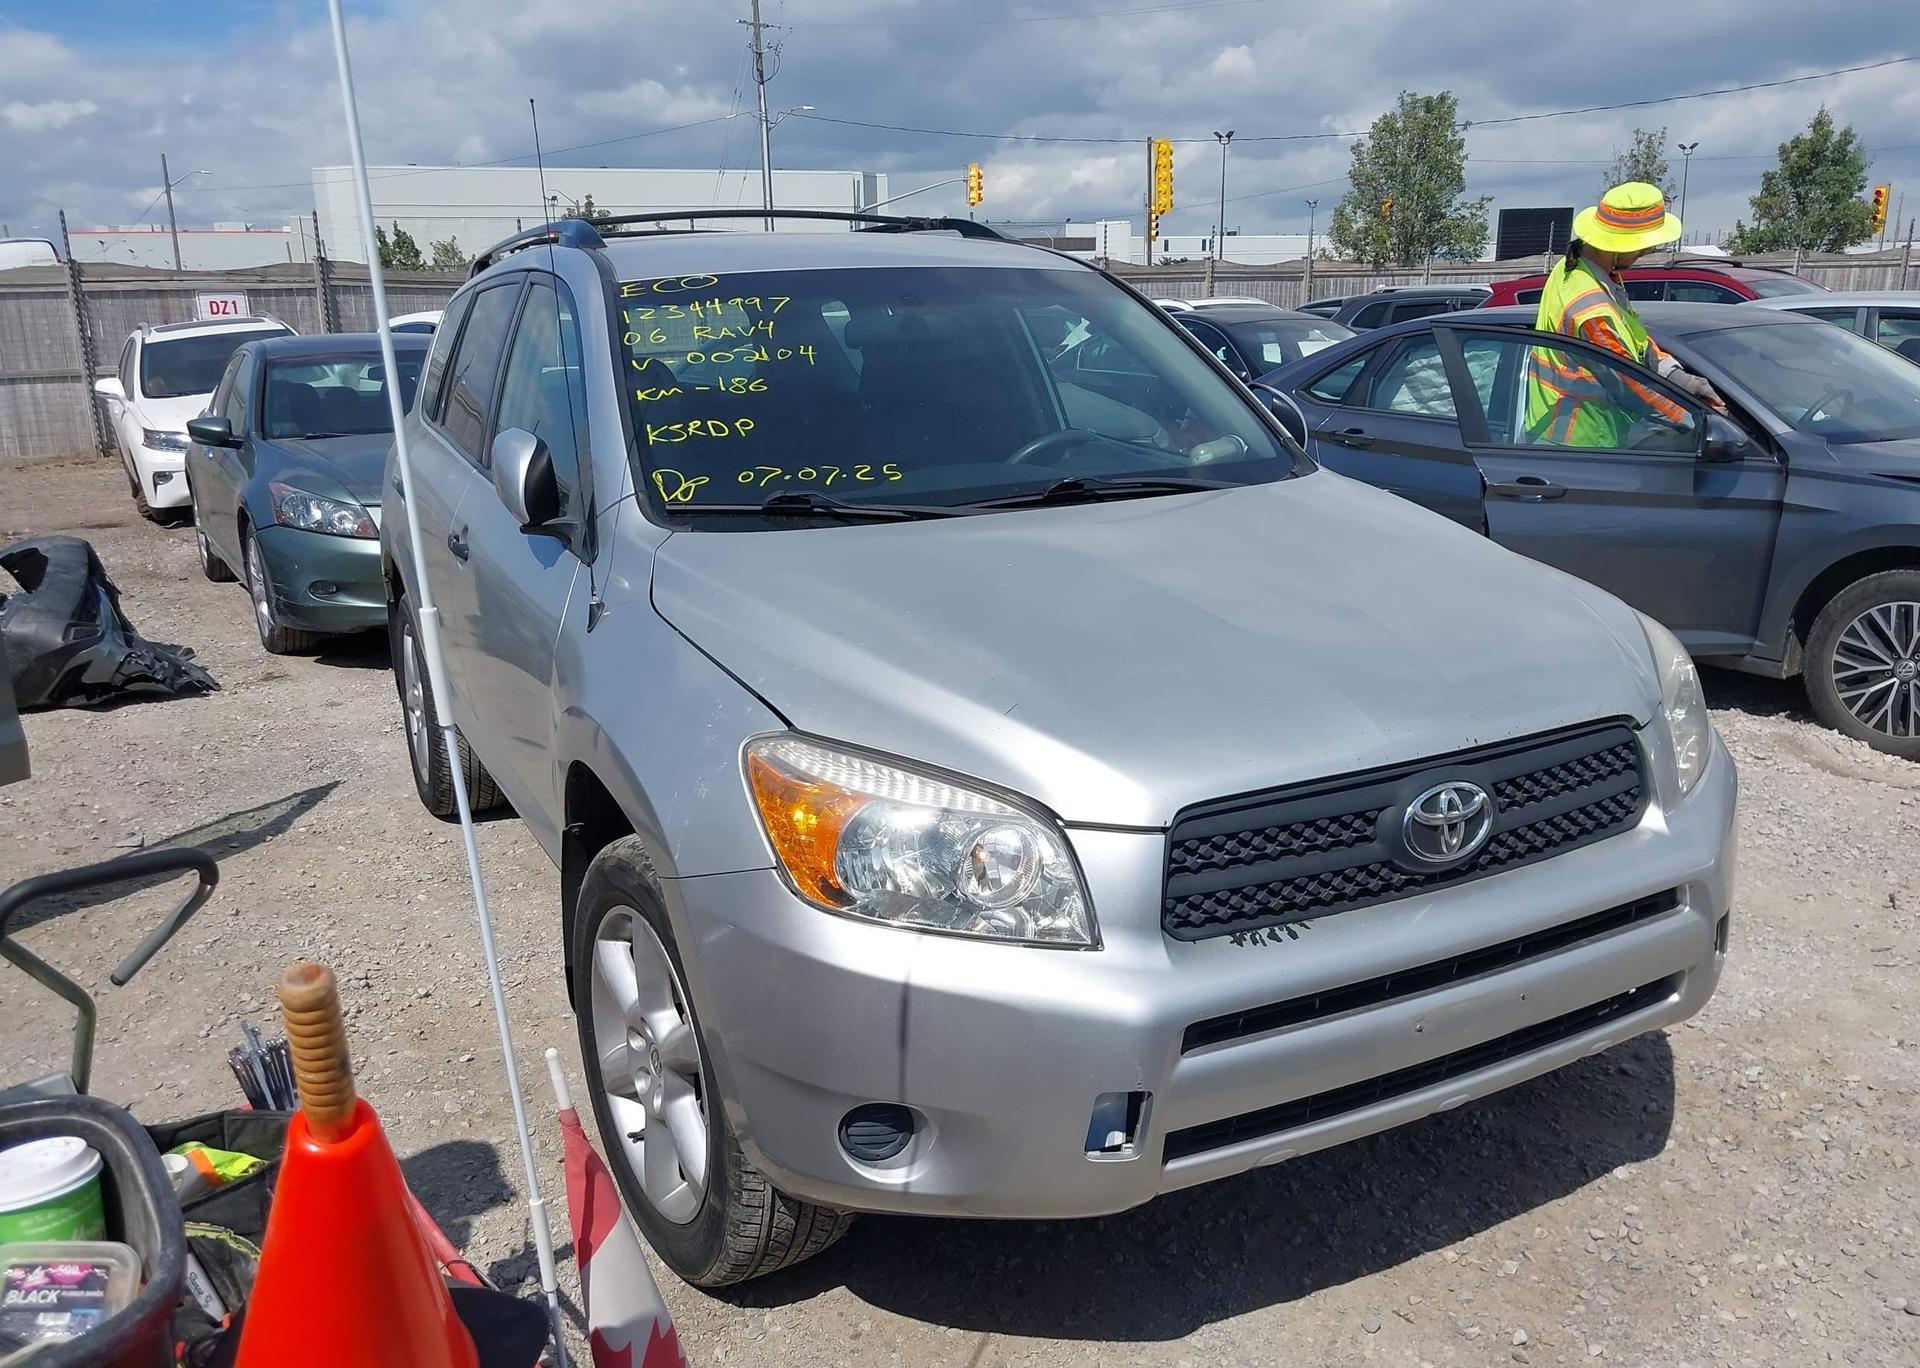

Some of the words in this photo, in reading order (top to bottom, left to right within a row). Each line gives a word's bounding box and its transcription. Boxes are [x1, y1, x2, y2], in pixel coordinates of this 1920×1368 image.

[620, 274, 718, 298] ECO
[208, 300, 239, 315] DZ1
[623, 297, 790, 324] 12344997
[623, 328, 667, 346] 06
[692, 319, 774, 341] RAV4
[5, 1289, 61, 1304] BLACK
